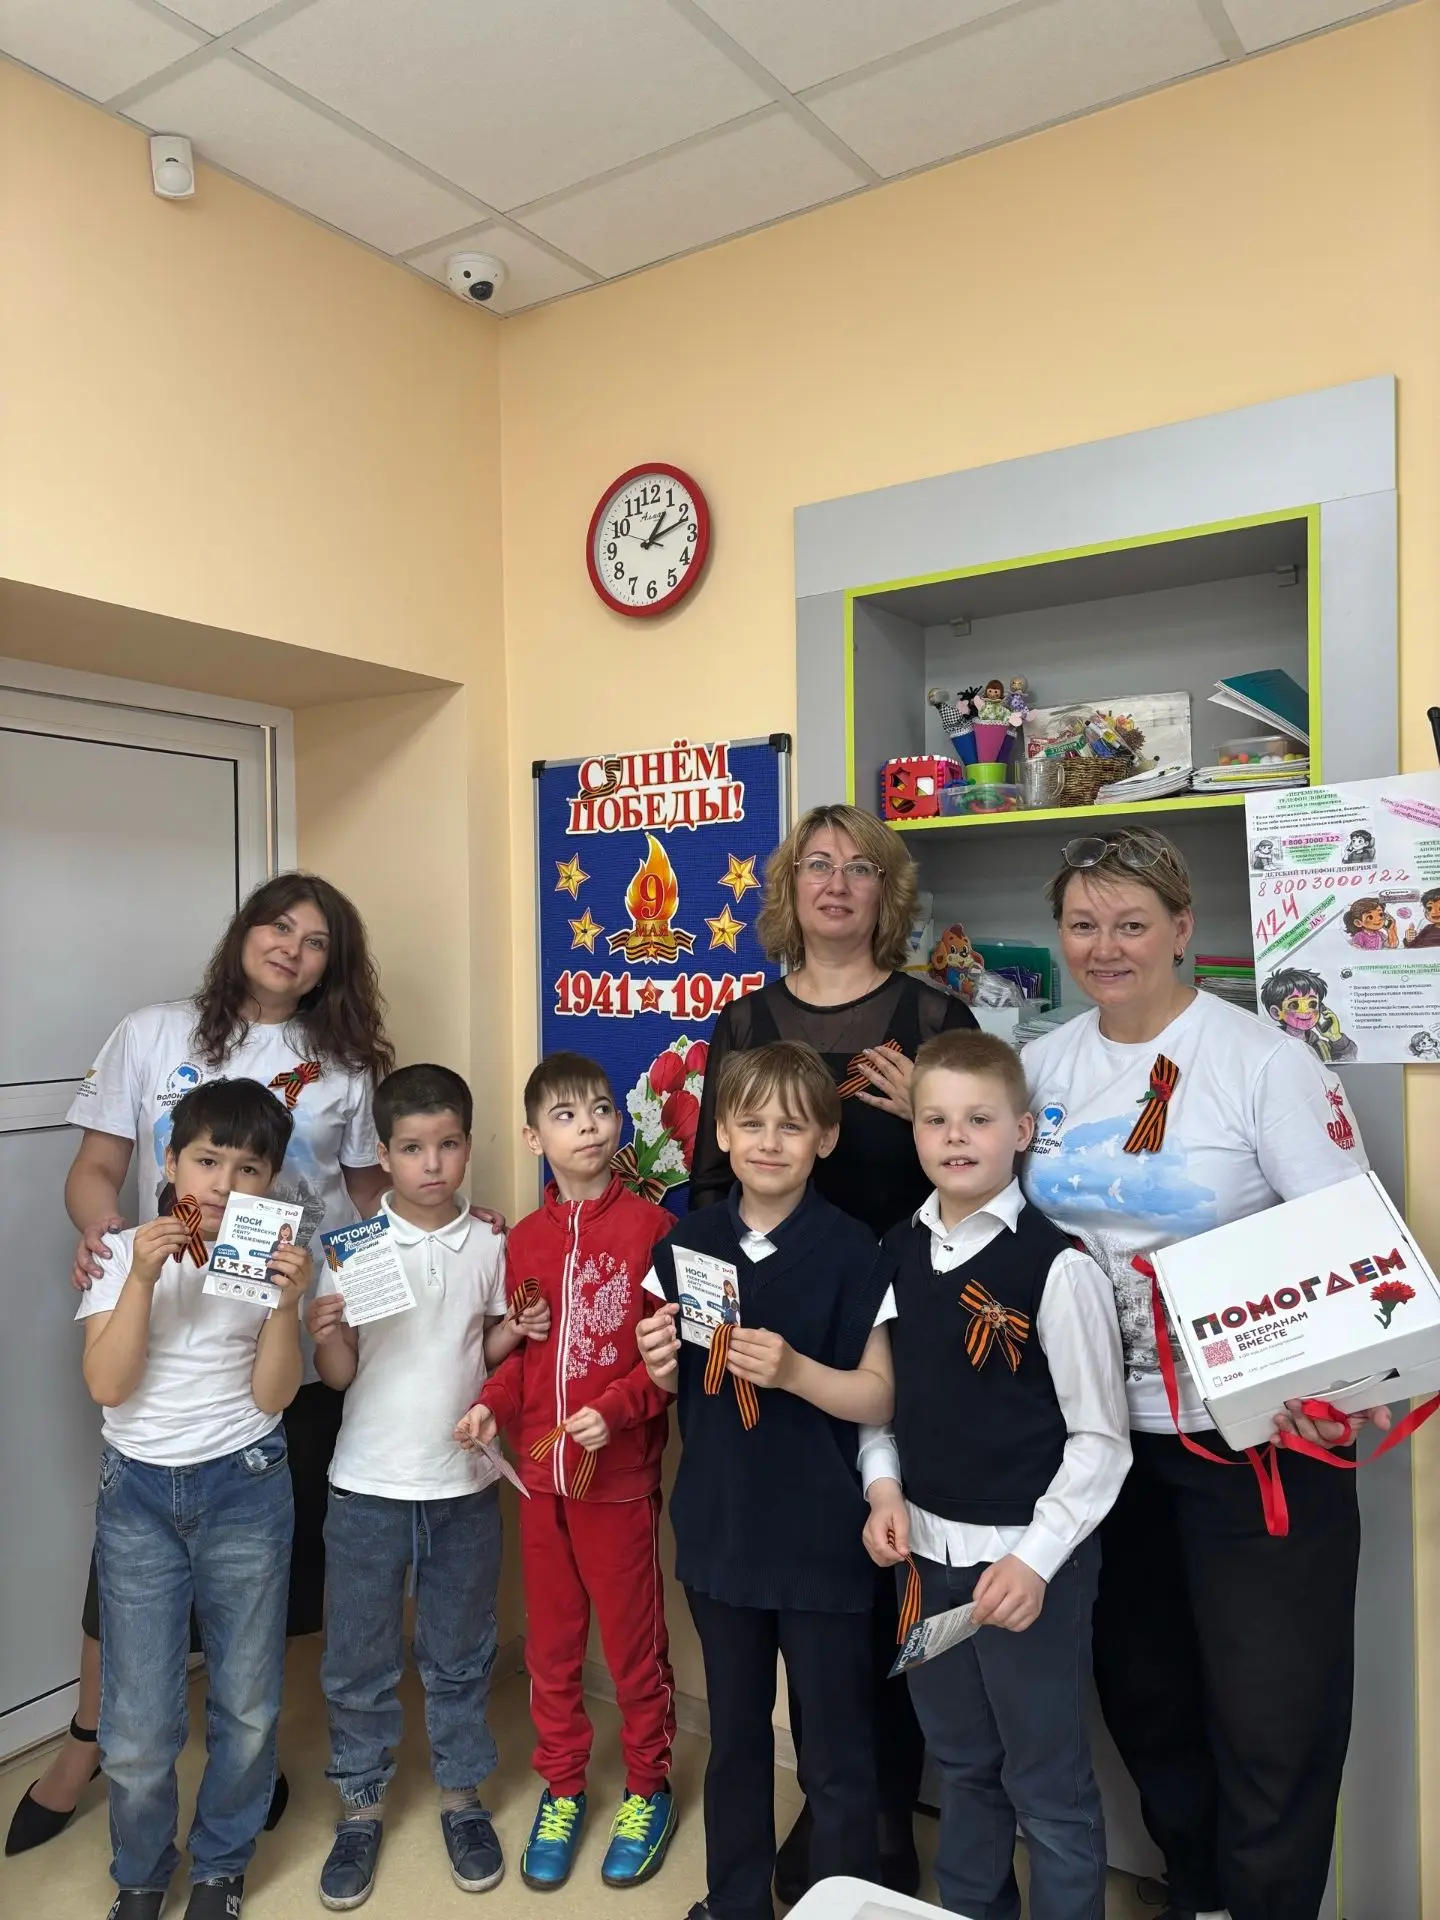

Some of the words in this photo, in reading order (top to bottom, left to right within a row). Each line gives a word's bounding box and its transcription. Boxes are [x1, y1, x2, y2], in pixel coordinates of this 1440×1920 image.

[640, 484, 661, 506] 12
[666, 488, 675, 507] 1
[624, 496, 643, 518] 11
[678, 503, 689, 523] 2
[612, 518, 631, 539] 10
[687, 523, 697, 542] 3
[607, 542, 617, 560] 9
[679, 546, 690, 565] 4
[613, 561, 625, 580] 8
[667, 567, 678, 587] 5
[628, 576, 638, 595] 7
[646, 580, 658, 599] 6
[612, 739, 730, 794] ДНЁМ
[569, 784, 744, 832] ПОБЕДЫ!
[1288, 838, 1303, 846] 800
[1304, 836, 1324, 845] 3000
[1325, 835, 1341, 843] 122
[1257, 881, 1267, 897] 8
[1273, 878, 1307, 895] 800
[1311, 875, 1363, 890] 3000
[1368, 868, 1410, 885] 122
[639, 874, 665, 920] 9
[635, 922, 669, 938] МАЯ
[555, 972, 634, 1016] 1941
[235, 1214, 262, 1226] НОСИ
[329, 1221, 382, 1246] ИСТОРИЯ
[685, 1266, 708, 1280] НОСИ
[1192, 1248, 1407, 1341] ПОМОГАЕМ
[1235, 1311, 1308, 1343] ВЕТЕРАНАМ
[1238, 1328, 1288, 1351] ВМЕСТЕ
[1223, 1371, 1244, 1382] 2206
